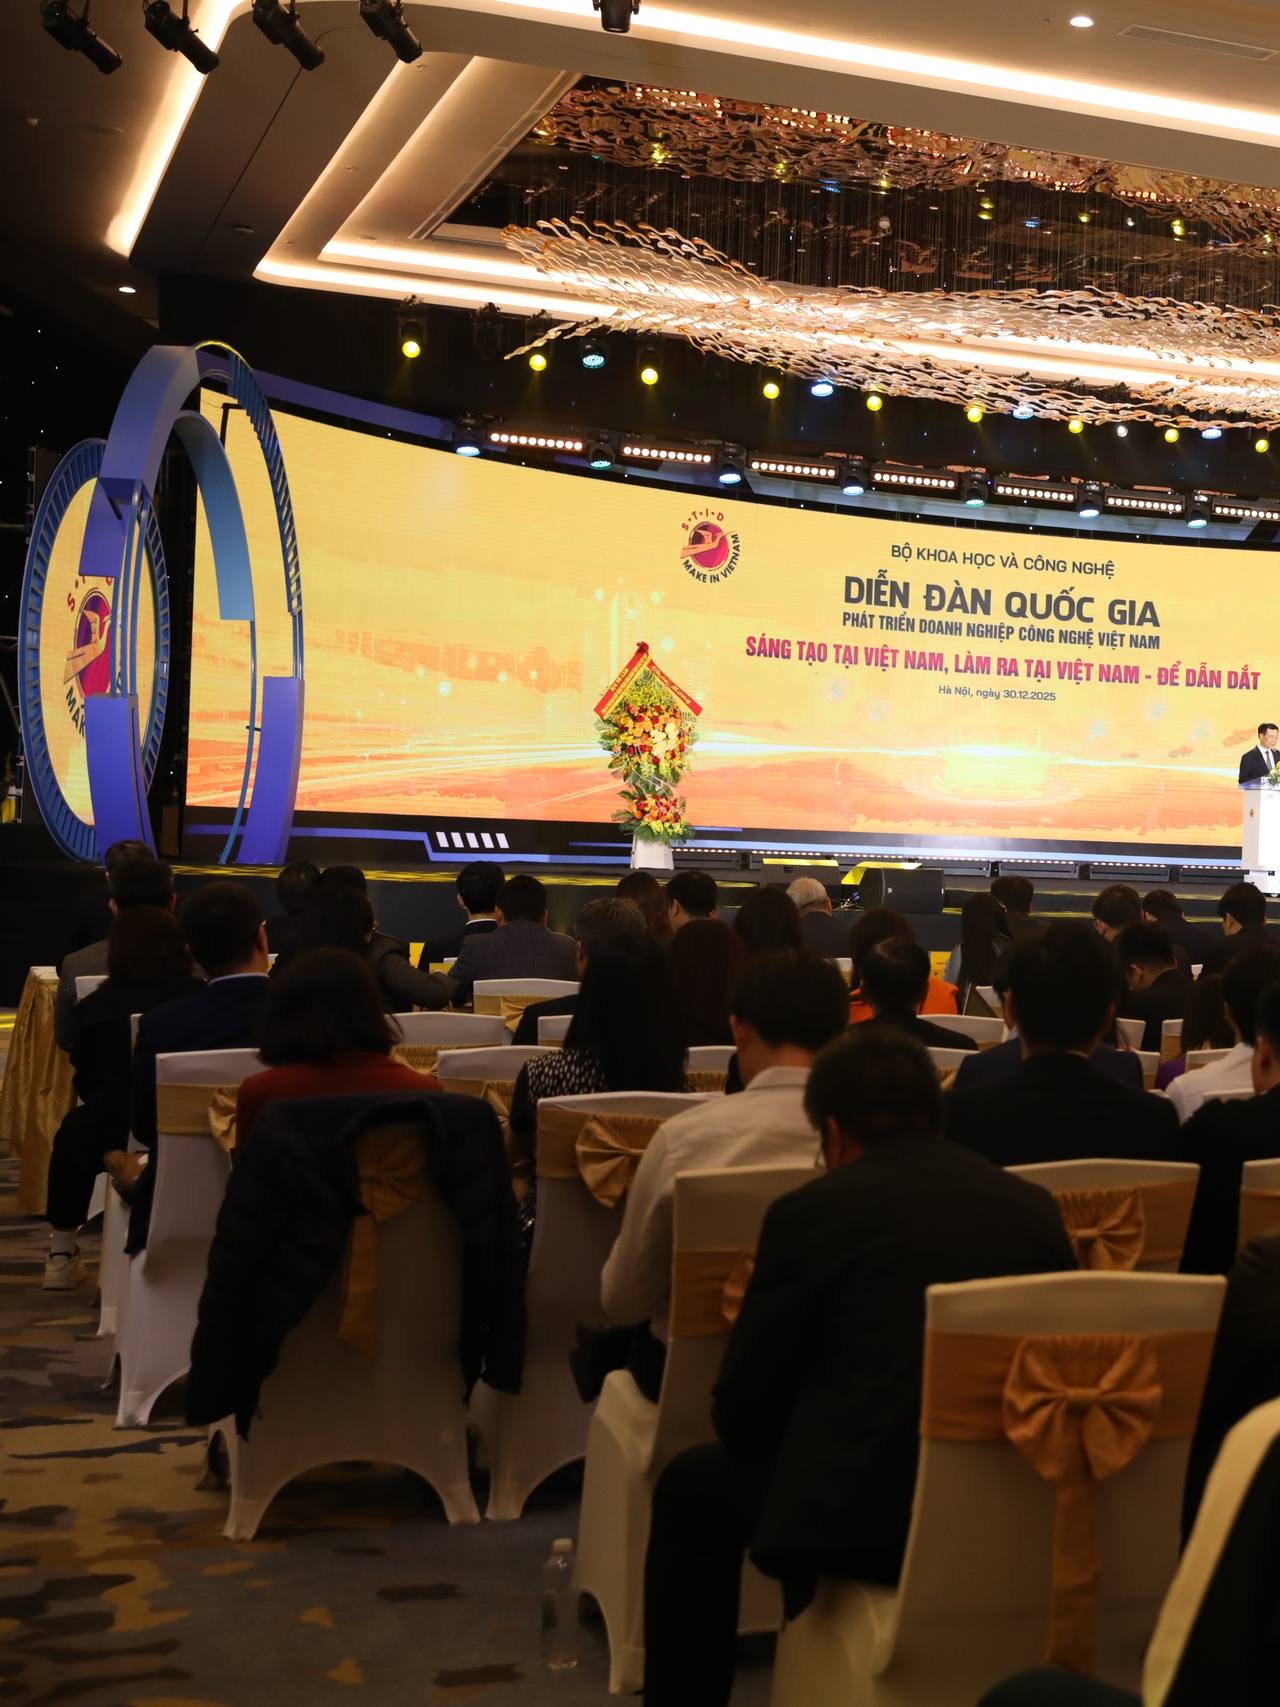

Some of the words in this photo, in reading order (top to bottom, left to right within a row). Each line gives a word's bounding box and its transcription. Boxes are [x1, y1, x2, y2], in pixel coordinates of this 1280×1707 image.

[682, 559, 707, 583] MAKE
[710, 574, 720, 584] IN
[720, 533, 741, 578] VIETNAM
[891, 542, 912, 562] BỘ
[916, 547, 958, 564] KHOA
[962, 552, 995, 569] HỌC
[1000, 552, 1019, 569] VÀ
[1023, 555, 1067, 573] CÔNG
[1071, 560, 1115, 580] NGHỆ
[844, 569, 910, 609] DIỄN
[923, 580, 991, 615] ĐÀN
[1005, 586, 1094, 623] QUỐC
[1108, 599, 1160, 627] GIA
[843, 611, 875, 629] PHÁT
[879, 611, 915, 632] TRIỂN
[919, 618, 962, 636] DOANH
[966, 622, 1015, 643] NGHIỆP
[1018, 624, 1055, 643] CÔNG
[1059, 628, 1094, 649] NGHỆ
[1098, 630, 1126, 650] VIỆT
[1129, 634, 1160, 650] NAM
[745, 633, 791, 660] SÁNG
[797, 640, 828, 666] TẠO
[833, 643, 858, 669] TẠI
[864, 644, 899, 672] VIỆT
[904, 650, 949, 675] NAM,
[954, 650, 991, 675] LÀM
[996, 657, 1019, 677] RA
[1024, 659, 1051, 683] TẠI
[1057, 658, 1094, 685] VIỆT
[1098, 664, 1139, 684] NAM
[1157, 660, 1182, 686] ĐỂ
[1185, 662, 1222, 688] DẪN
[1227, 664, 1261, 690] DẮT
[66, 685, 86, 738] MAK
[938, 685, 951, 695] Hà
[954, 686, 973, 698] Nội,
[976, 688, 1000, 700] ngày
[1003, 689, 1056, 701] 30.12.2025
